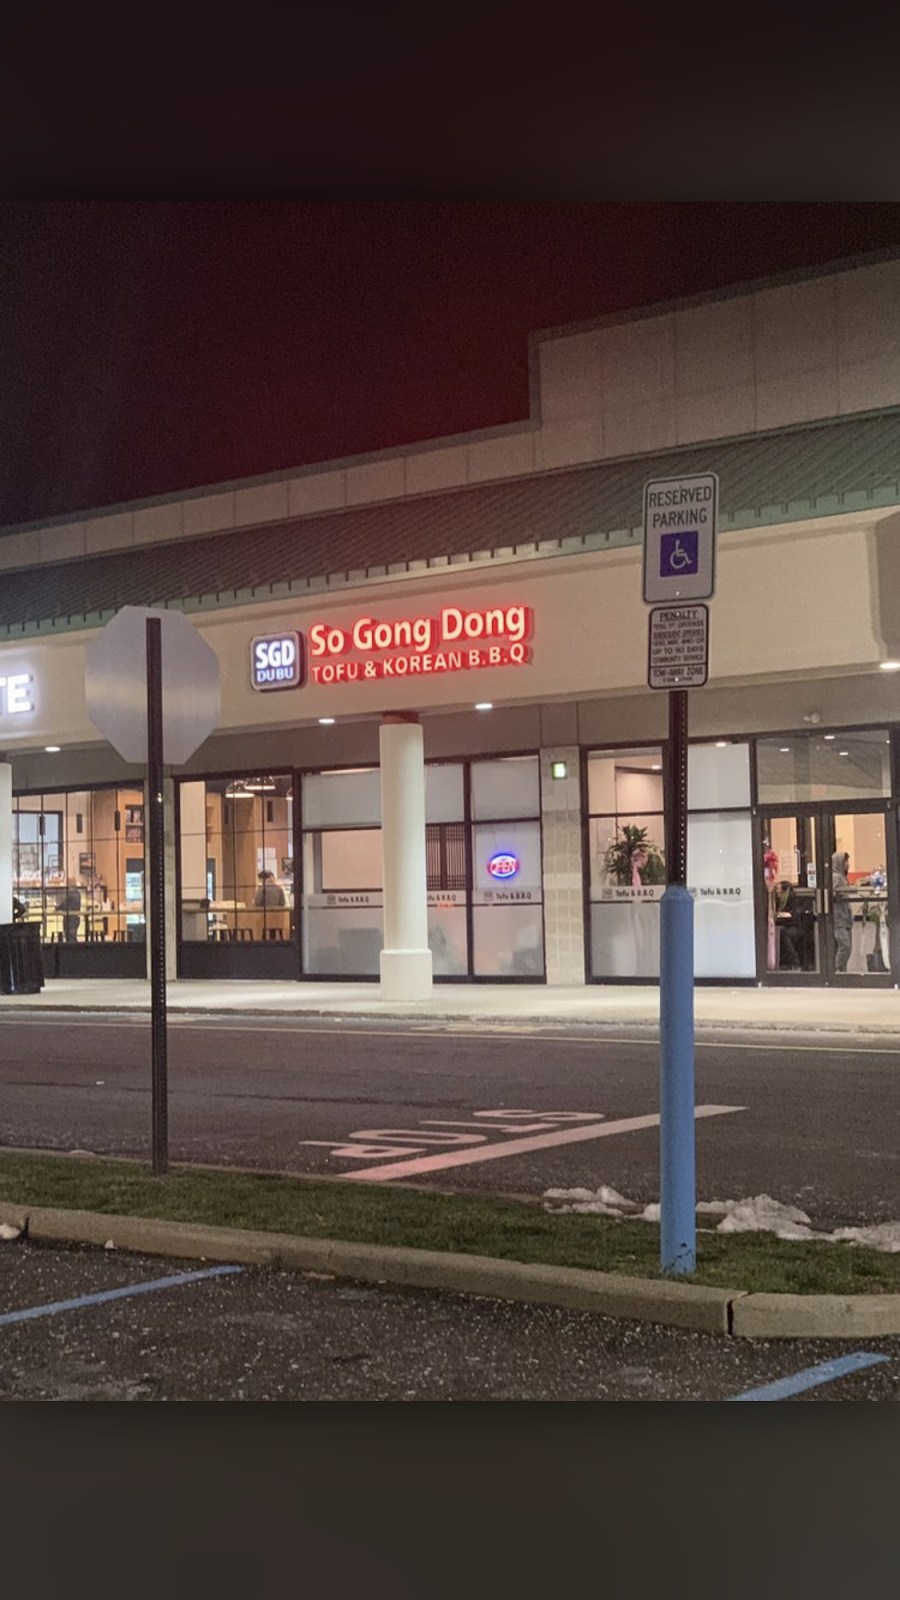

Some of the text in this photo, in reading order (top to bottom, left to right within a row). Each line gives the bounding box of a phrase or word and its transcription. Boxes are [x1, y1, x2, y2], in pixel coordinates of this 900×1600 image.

[649, 485, 712, 508] RESERVED
[652, 507, 708, 529] PARKING
[660, 609, 698, 621] PENALTY
[310, 605, 528, 656] So Gong Dong
[255, 639, 296, 669] SGD
[312, 642, 526, 682] TOFU & KOREAN B.B.Q
[664, 647, 673, 655] TO
[256, 667, 294, 683] DUBU
[488, 859, 518, 874] OPEN
[700, 887, 715, 896] Tofu
[298, 1109, 605, 1159] STOP
